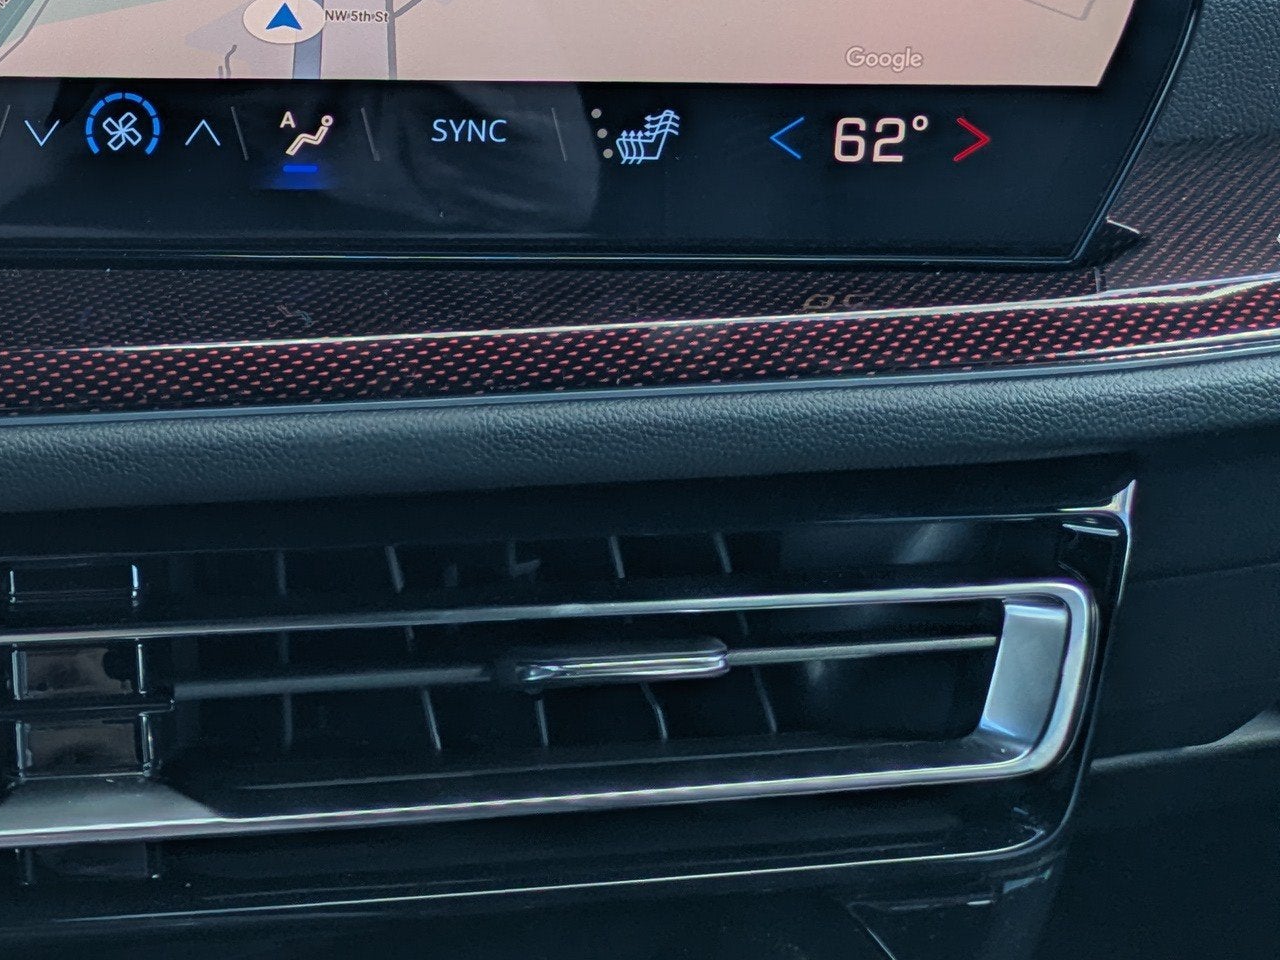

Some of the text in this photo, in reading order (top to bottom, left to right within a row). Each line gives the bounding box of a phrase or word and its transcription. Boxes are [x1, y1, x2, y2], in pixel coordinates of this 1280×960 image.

[324, 10, 388, 22] NW 5th St
[846, 47, 923, 72] Google
[279, 111, 296, 129] A
[432, 119, 508, 142] SYNC
[834, 114, 929, 162] 62°
